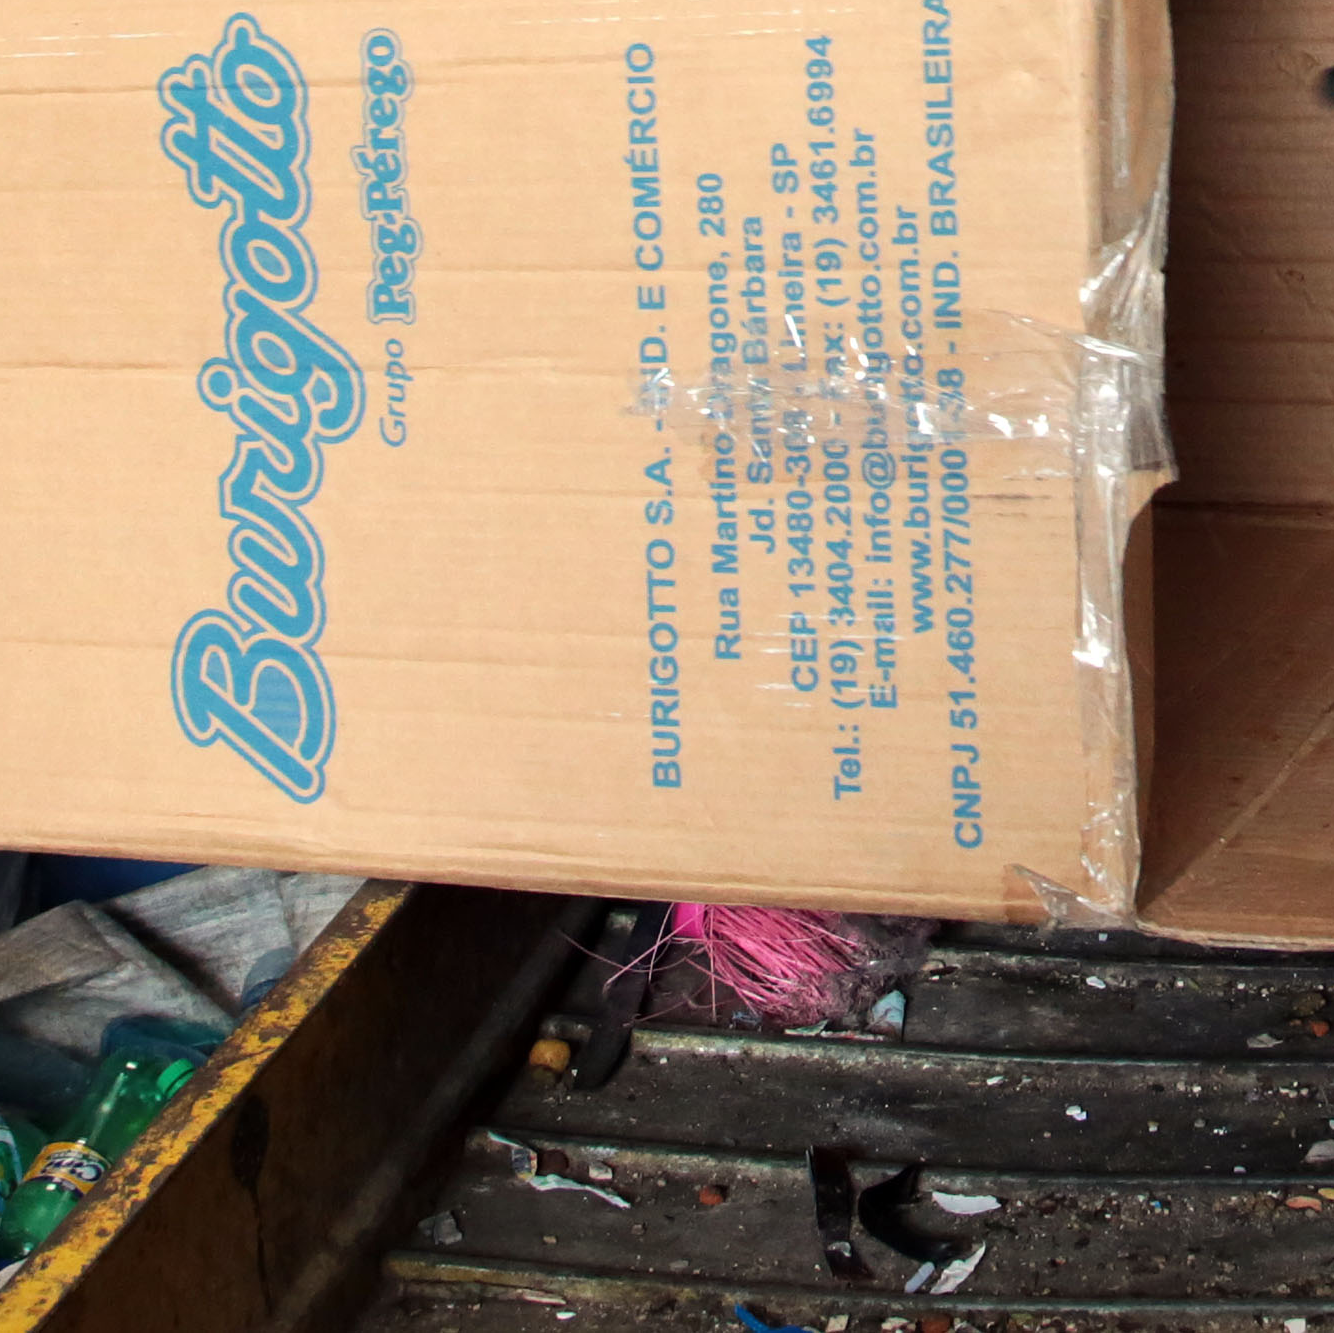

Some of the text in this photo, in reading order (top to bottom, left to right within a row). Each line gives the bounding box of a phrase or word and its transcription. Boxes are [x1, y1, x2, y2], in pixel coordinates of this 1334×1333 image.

[624, 43, 664, 271] COMÉRCIO
[771, 144, 799, 194] SP
[806, 37, 839, 223] 3461.6994
[351, 26, 423, 447] Grupo Peg-Pérego
[697, 174, 725, 236] 280
[638, 287, 665, 310] E
[741, 217, 768, 364] Bárbara
[814, 238, 849, 307] (19)
[933, 252, 961, 328] IND.
[156, 12, 365, 804] Burigotto
[645, 448, 673, 525] S.A.
[710, 434, 738, 574] Martino
[749, 500, 776, 554] Jd.
[823, 440, 855, 626] 3404.2000
[646, 539, 681, 788] BURIGOTTO
[715, 588, 741, 659] Rua
[790, 612, 819, 692] CEP
[867, 580, 898, 708] E-mail:
[830, 640, 865, 709] (19)
[833, 726, 862, 799] Tel.:
[951, 744, 983, 848] CNPJ
